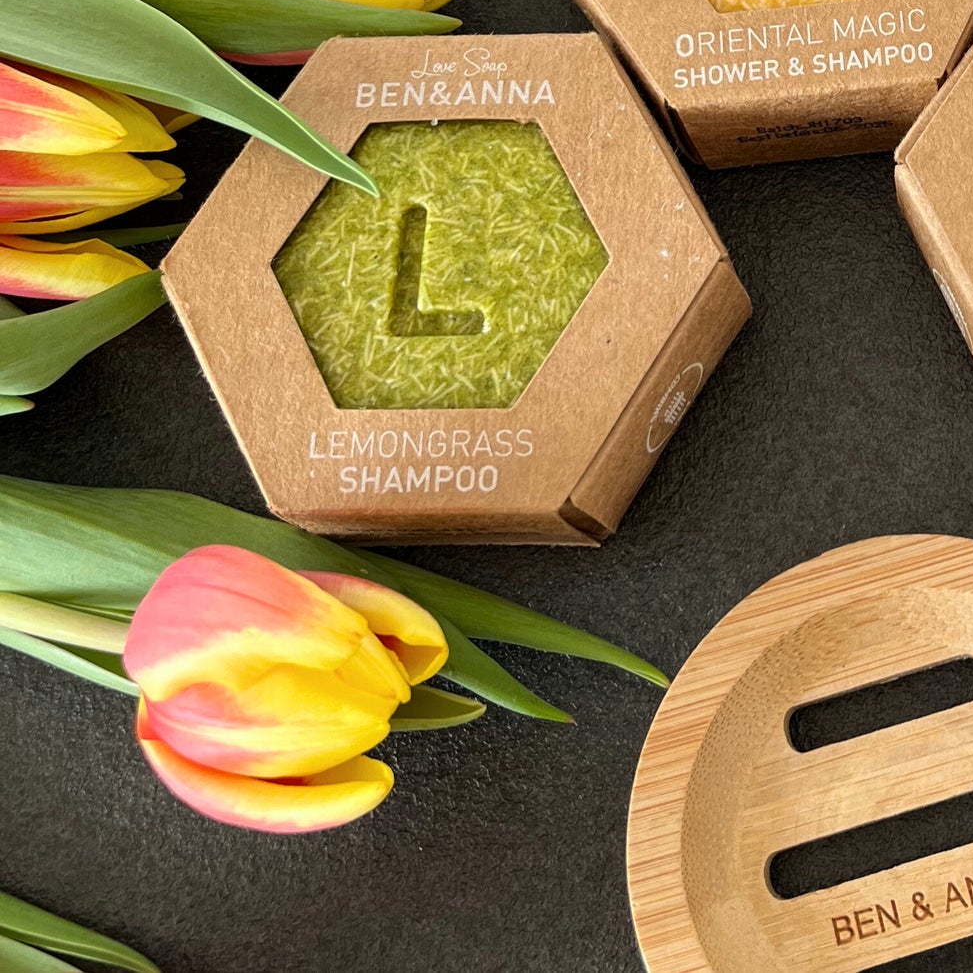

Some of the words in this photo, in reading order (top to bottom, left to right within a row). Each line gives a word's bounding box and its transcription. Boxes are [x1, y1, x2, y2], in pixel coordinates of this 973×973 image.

[675, 22, 824, 58] ORIENTAL
[832, 8, 926, 42] MAGIC
[411, 49, 457, 78] Love
[463, 47, 507, 80] Soap
[673, 59, 780, 89] SHOWER
[788, 57, 805, 78] &
[812, 41, 933, 74] SHAMPOO
[355, 79, 556, 109] BEN&ANNA
[389, 203, 485, 337] L
[309, 429, 533, 459] LEMONGRASS
[339, 464, 499, 494] SHAMPOO
[831, 899, 901, 946] BEN
[911, 891, 934, 921] &
